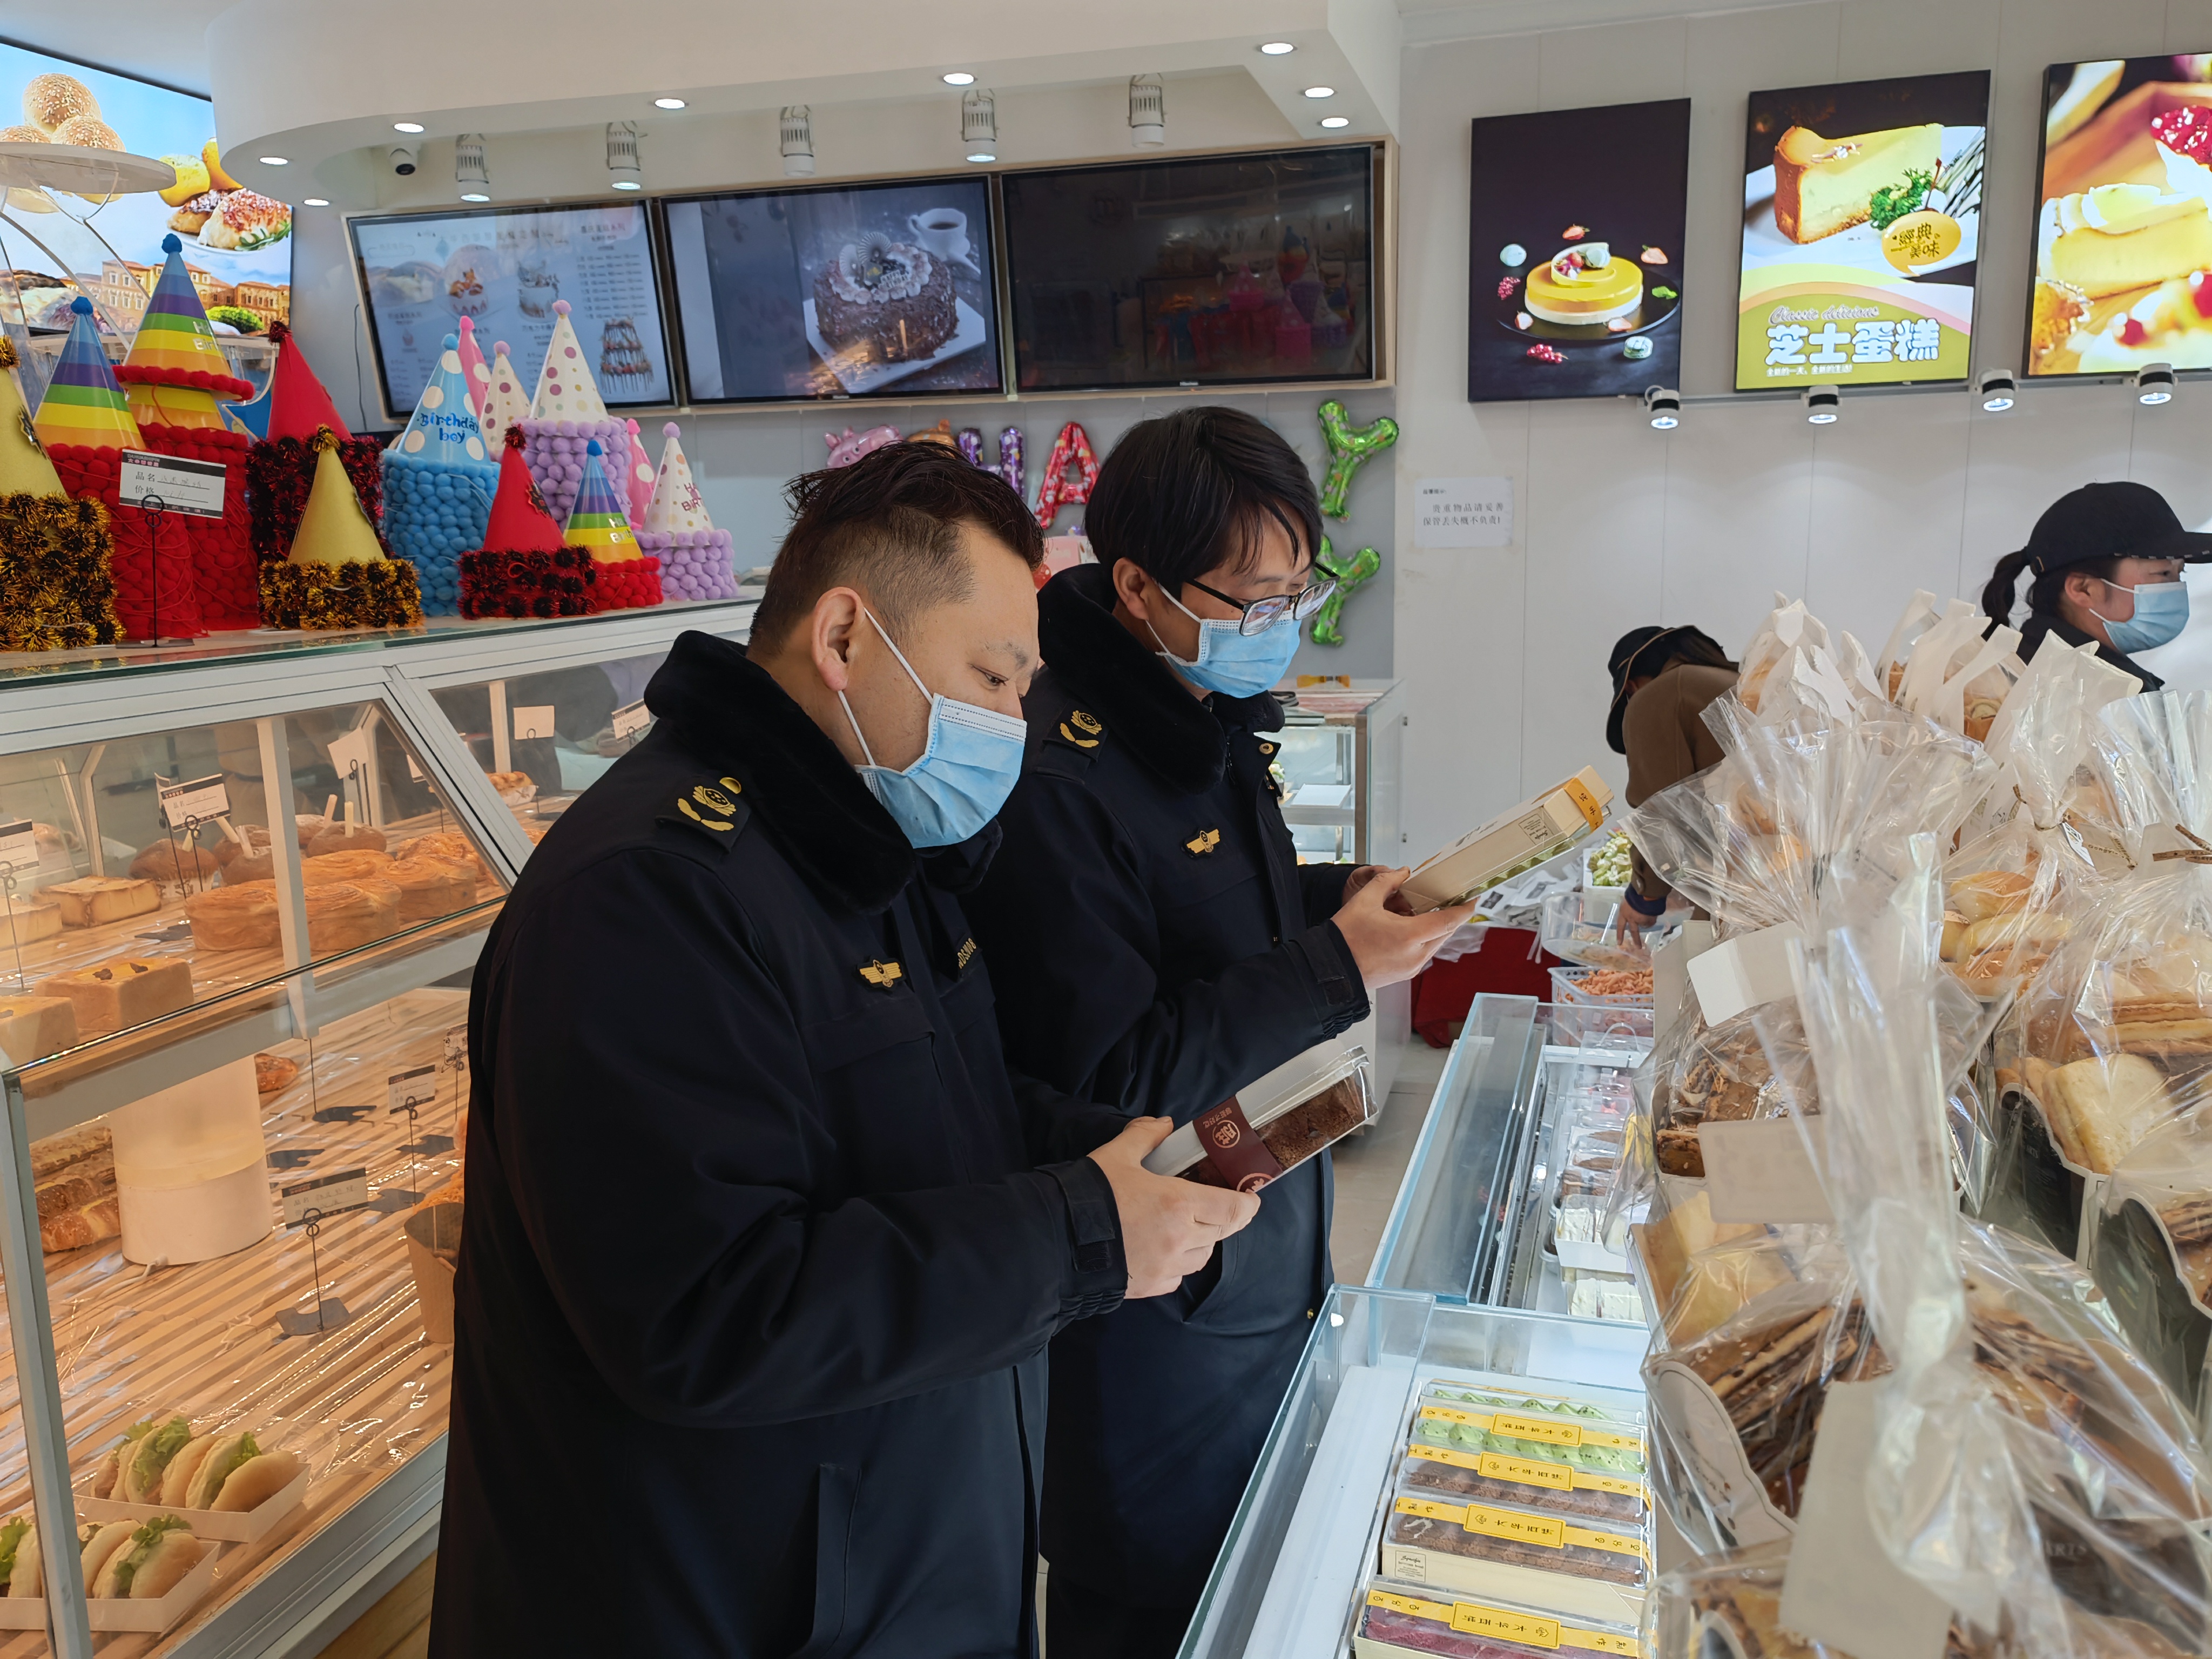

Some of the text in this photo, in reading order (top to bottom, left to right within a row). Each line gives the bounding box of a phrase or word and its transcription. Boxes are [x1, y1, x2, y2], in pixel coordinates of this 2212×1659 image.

[1910, 240, 1940, 259] 美味
[1765, 318, 1940, 366] 芝士蛋糕
[420, 412, 479, 434] Birthday
[439, 428, 466, 444] boy
[136, 471, 156, 483] 品名
[135, 485, 154, 495] 价格
[1433, 502, 1504, 514] 贵重物品请妥善
